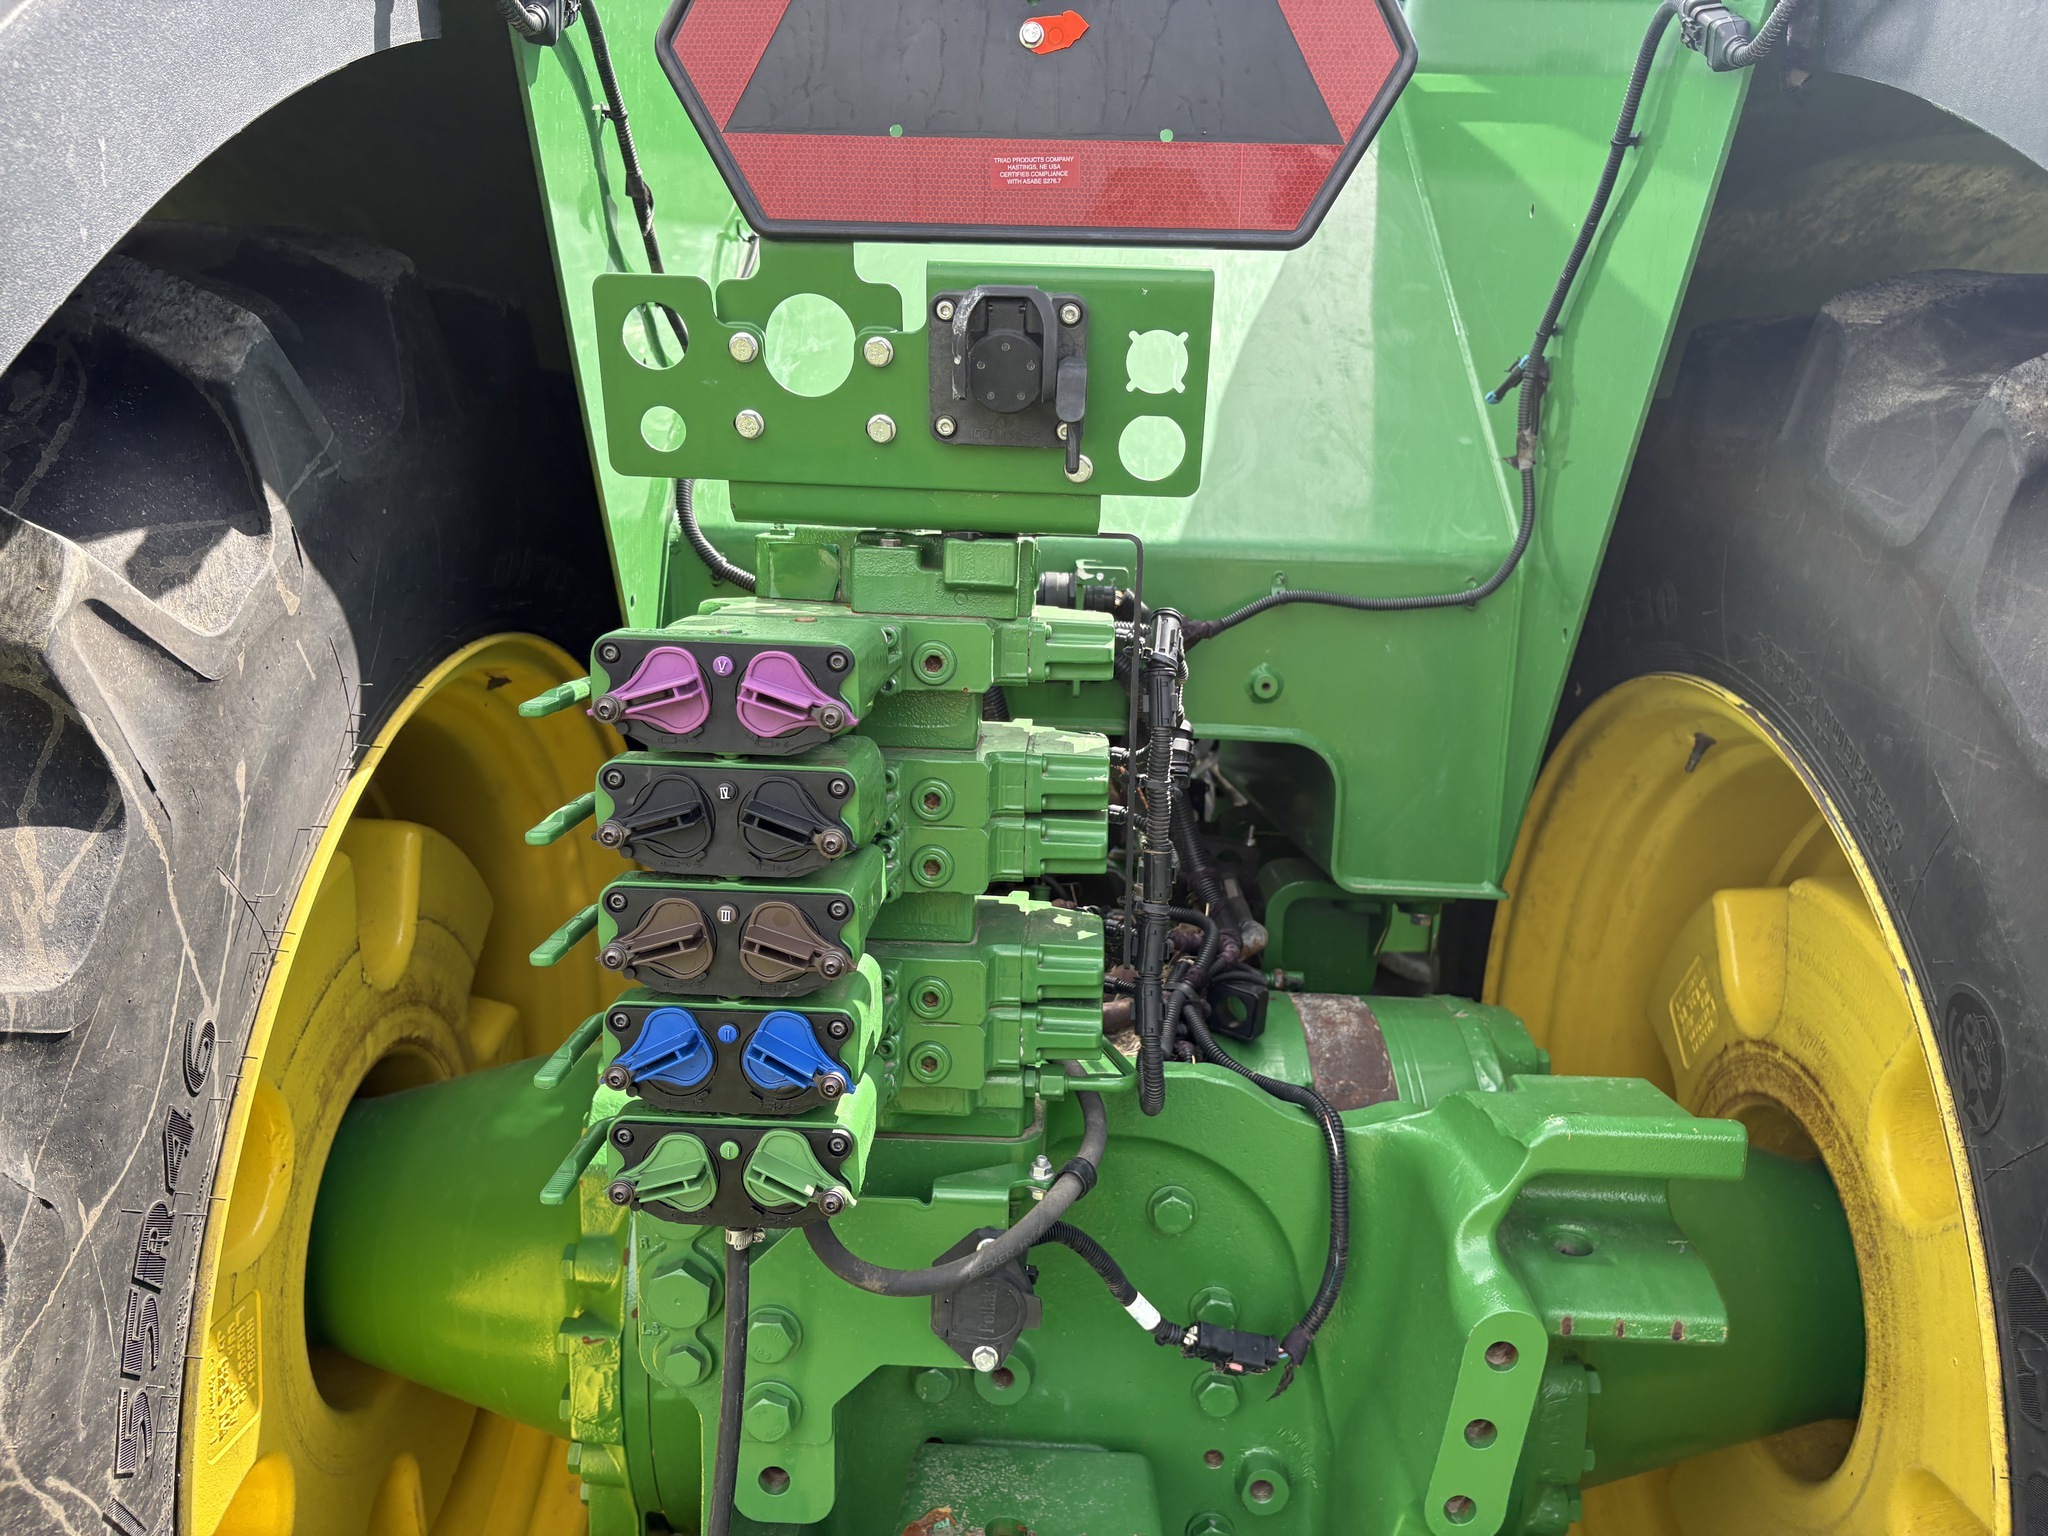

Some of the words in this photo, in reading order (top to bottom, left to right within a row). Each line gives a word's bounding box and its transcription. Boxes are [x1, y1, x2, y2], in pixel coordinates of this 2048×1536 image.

[717, 660, 728, 673] V
[719, 787, 730, 800] IV
[720, 909, 732, 922] III
[968, 1248, 1015, 1279] BECKER
[978, 1288, 997, 1333] Pollak
